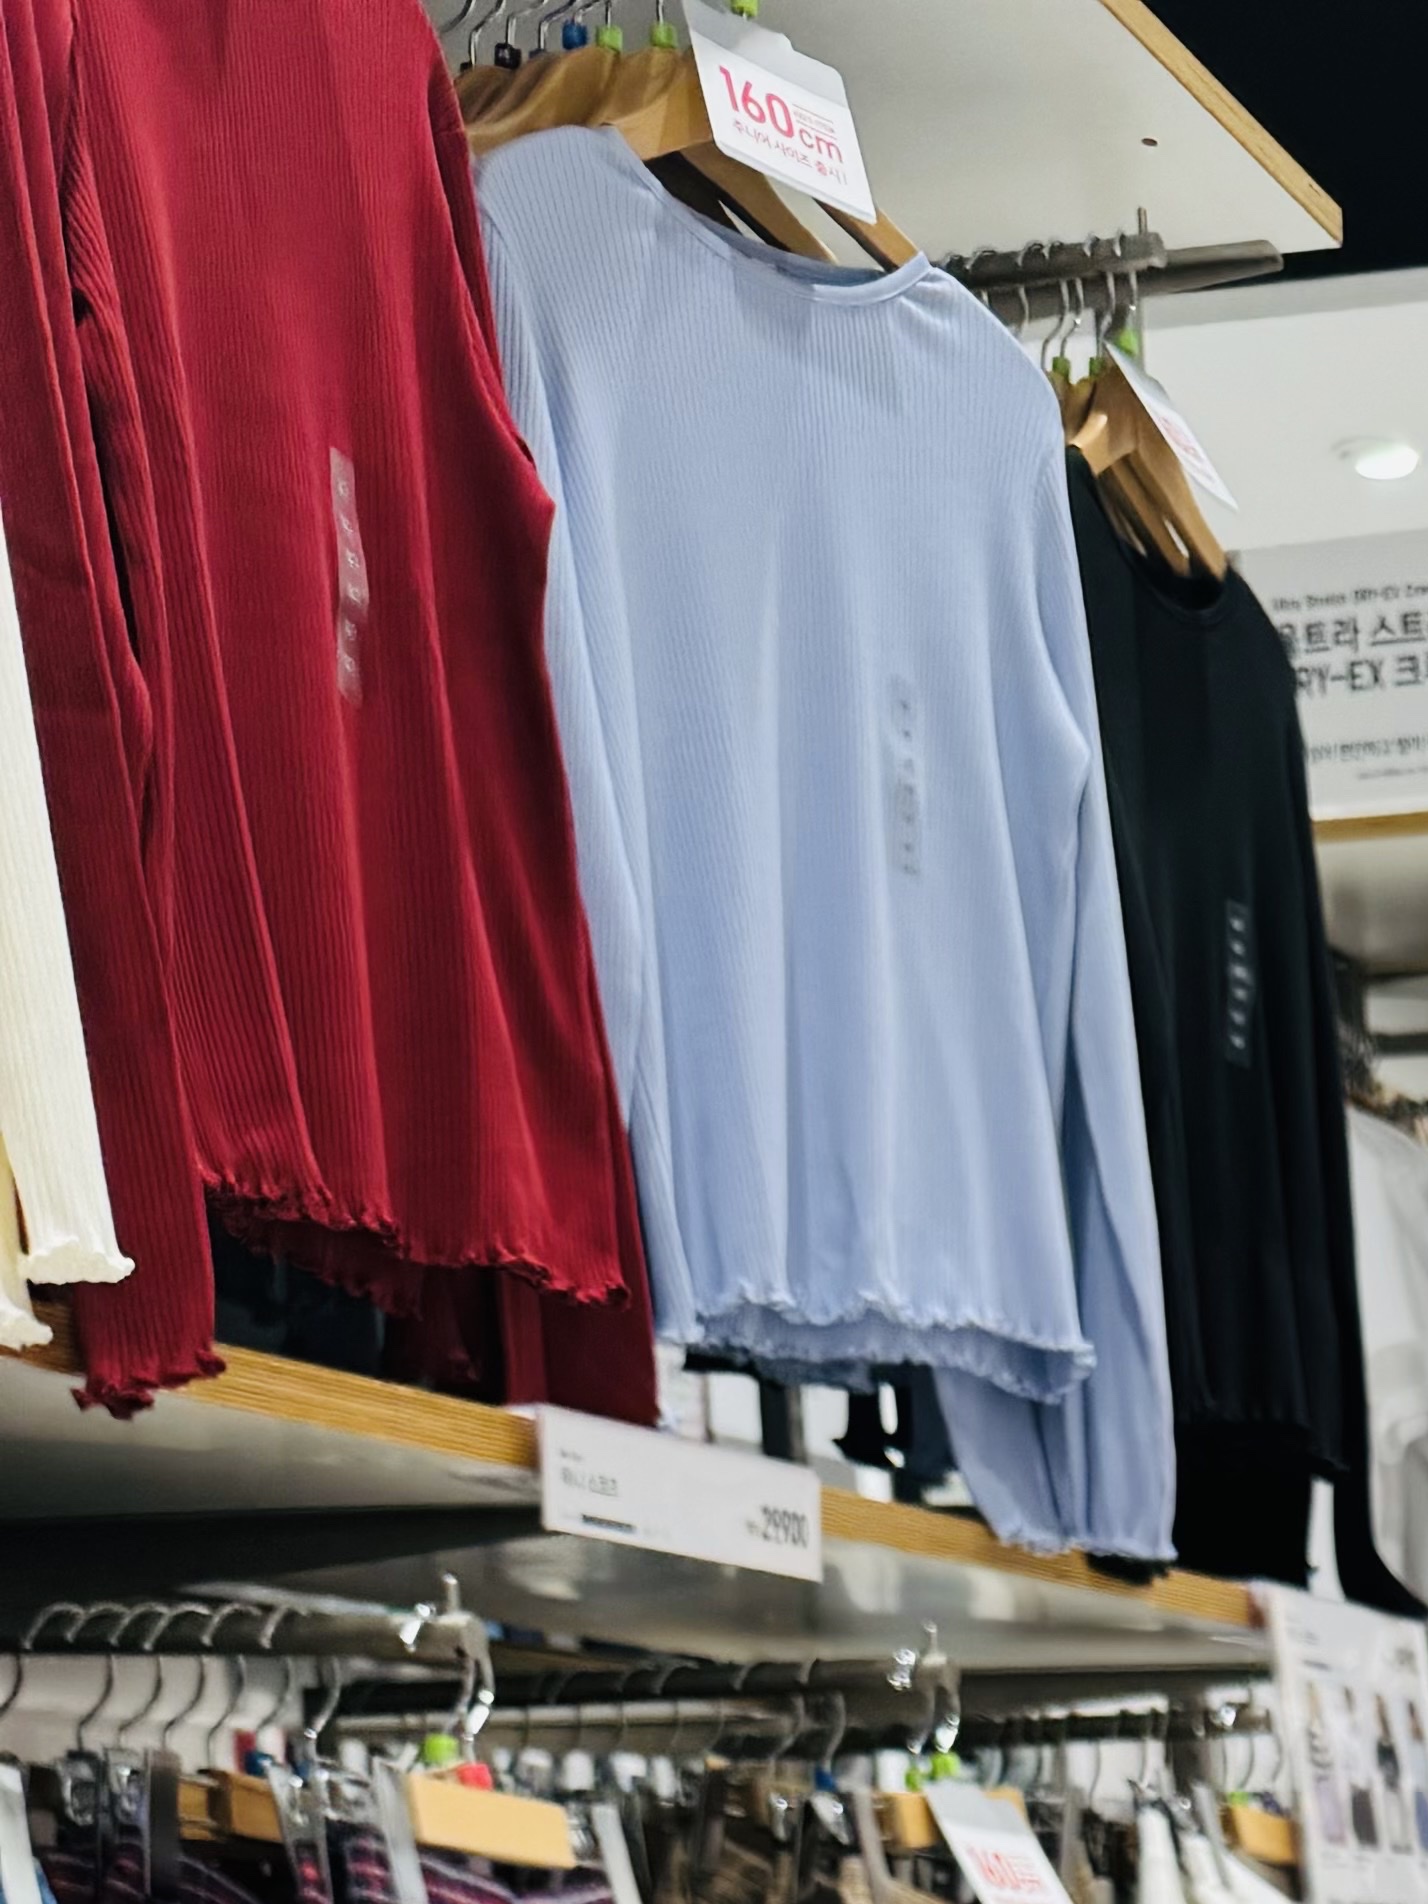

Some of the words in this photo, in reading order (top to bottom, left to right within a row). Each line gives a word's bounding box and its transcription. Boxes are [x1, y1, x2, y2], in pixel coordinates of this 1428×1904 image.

[719, 64, 795, 139] 160
[798, 127, 844, 164] cm
[732, 118, 772, 150] 주니어
[775, 141, 813, 169] 사이즈
[1296, 658, 1385, 698] RY-EX
